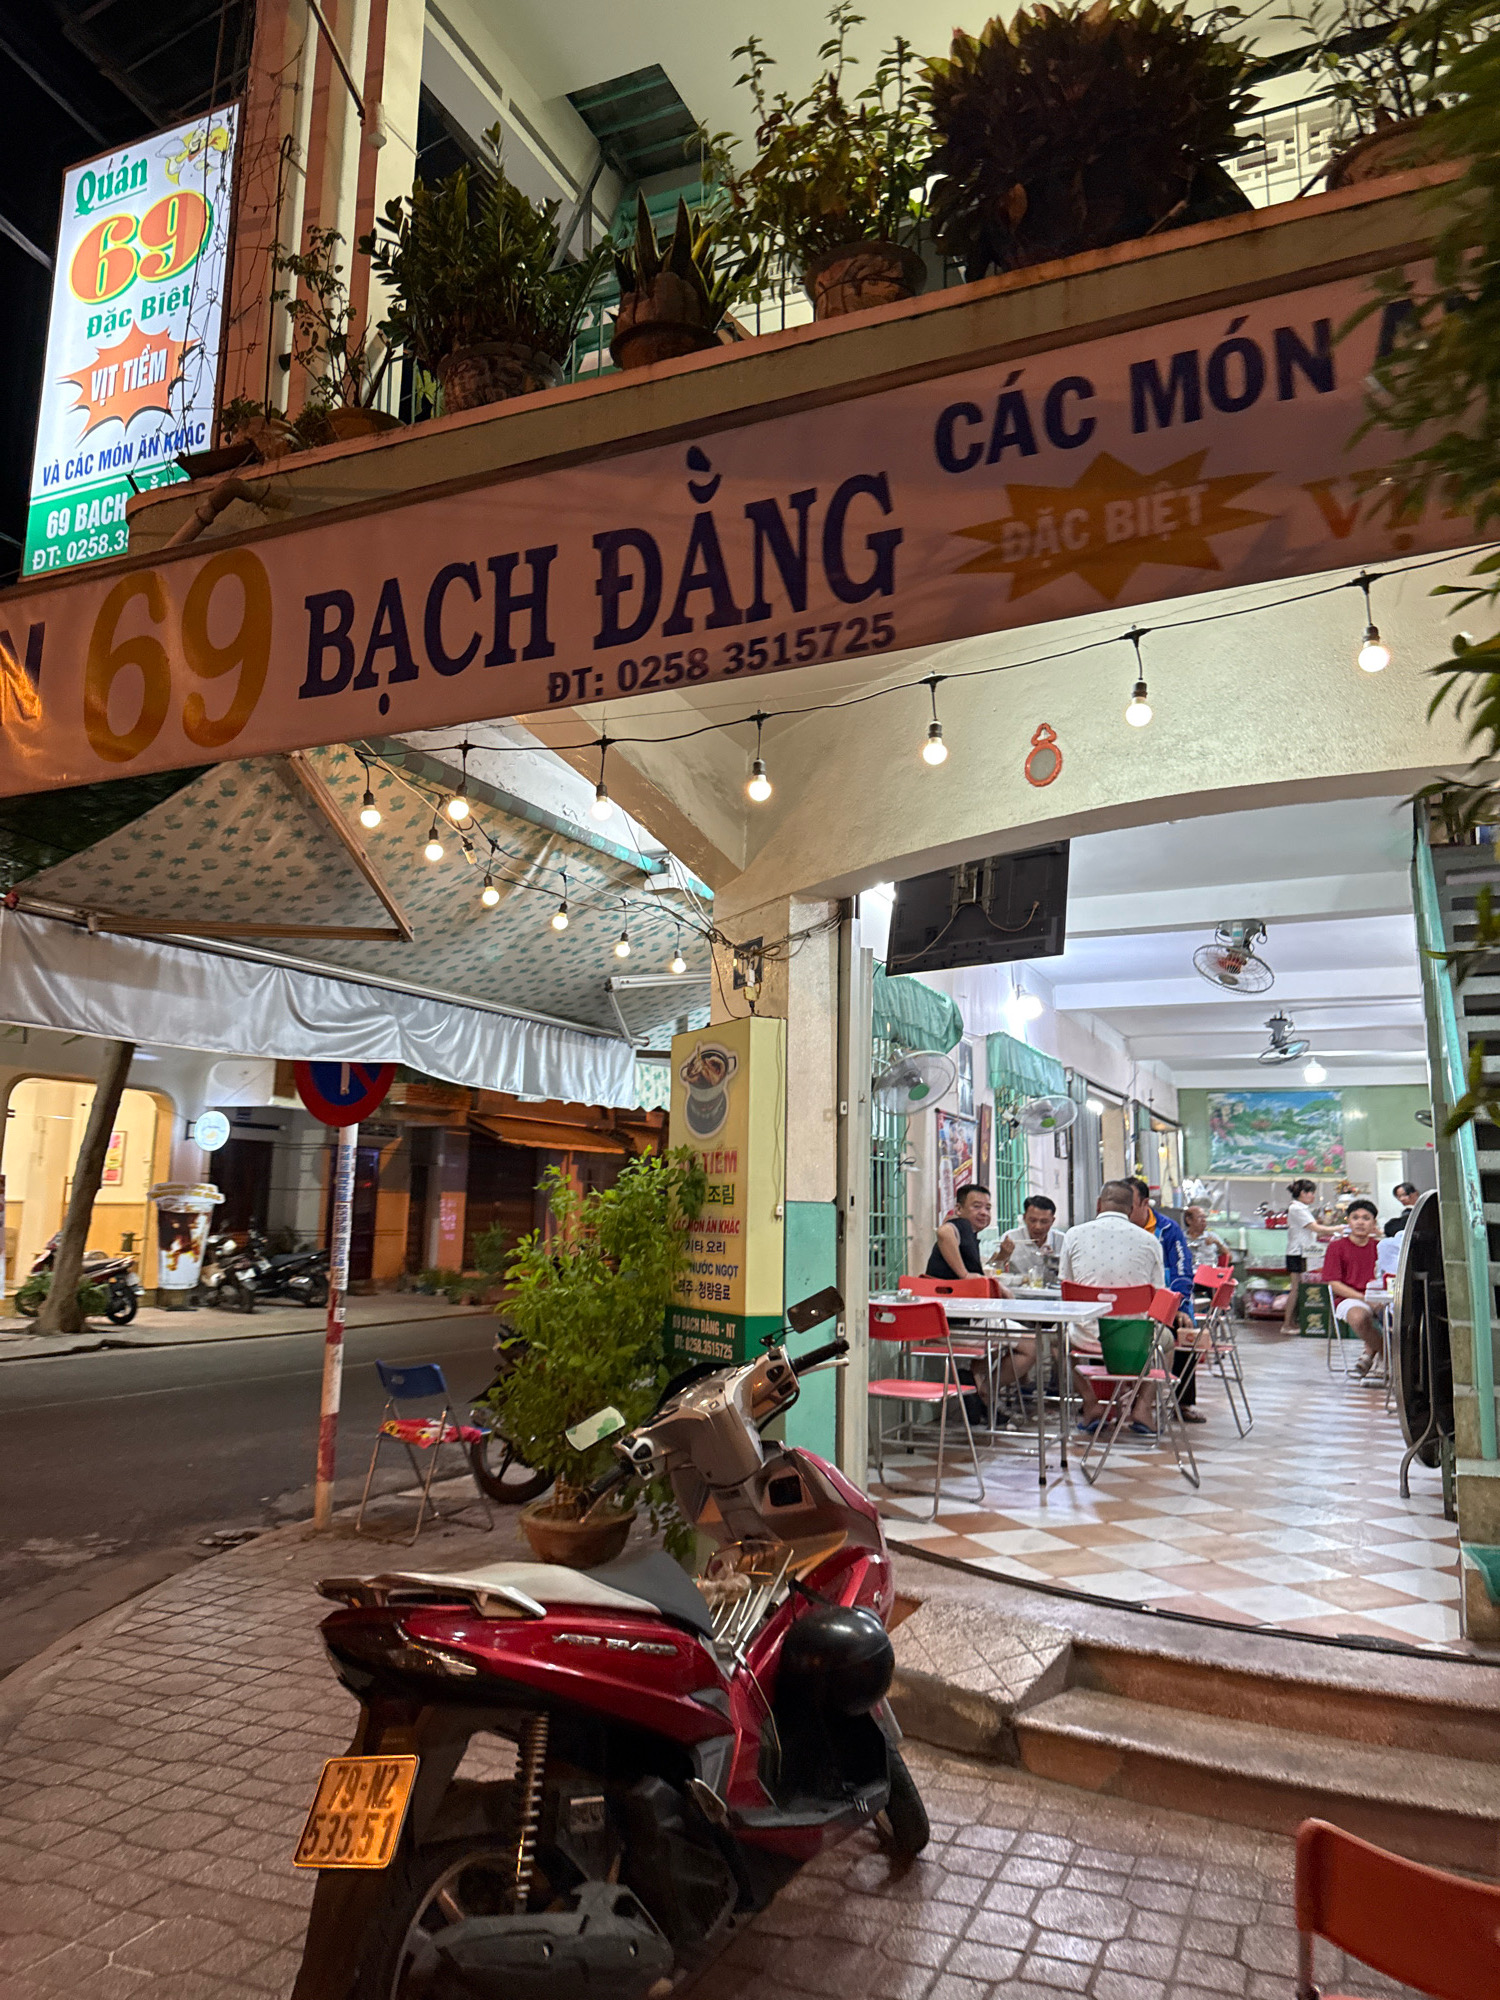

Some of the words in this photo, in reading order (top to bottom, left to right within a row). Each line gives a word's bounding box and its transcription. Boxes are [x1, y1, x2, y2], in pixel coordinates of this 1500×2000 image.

[75, 154, 148, 215] Quán
[69, 189, 214, 304] 69
[86, 307, 132, 339] Đặc
[141, 284, 192, 320] Biệt
[91, 363, 120, 407] VỊT
[123, 343, 168, 393] TIỀM
[933, 368, 1097, 474] CÁC
[1129, 315, 1336, 434] MÓN
[43, 459, 60, 487] VÀ
[65, 452, 94, 480] CÁC
[98, 442, 134, 472] MÓN
[138, 434, 160, 460] ĂN
[163, 420, 206, 453] KHÁC
[46, 508, 71, 539] 69
[74, 491, 129, 535] BẠCH
[1000, 505, 1090, 568] ĐẶC
[1104, 480, 1209, 544] BIỆT
[32, 545, 61, 571] ĐT:
[83, 546, 273, 763] 69
[298, 544, 558, 716] BẠCH
[592, 444, 905, 650] ĐẰNG
[547, 666, 604, 700] ĐT:
[616, 647, 710, 693] 0258
[722, 610, 896, 676] 3515725
[706, 1240, 726, 1255] 요리
[715, 1263, 739, 1281] NGỌT
[725, 1322, 737, 1340] NT
[302, 1810, 396, 1860] 535.51
